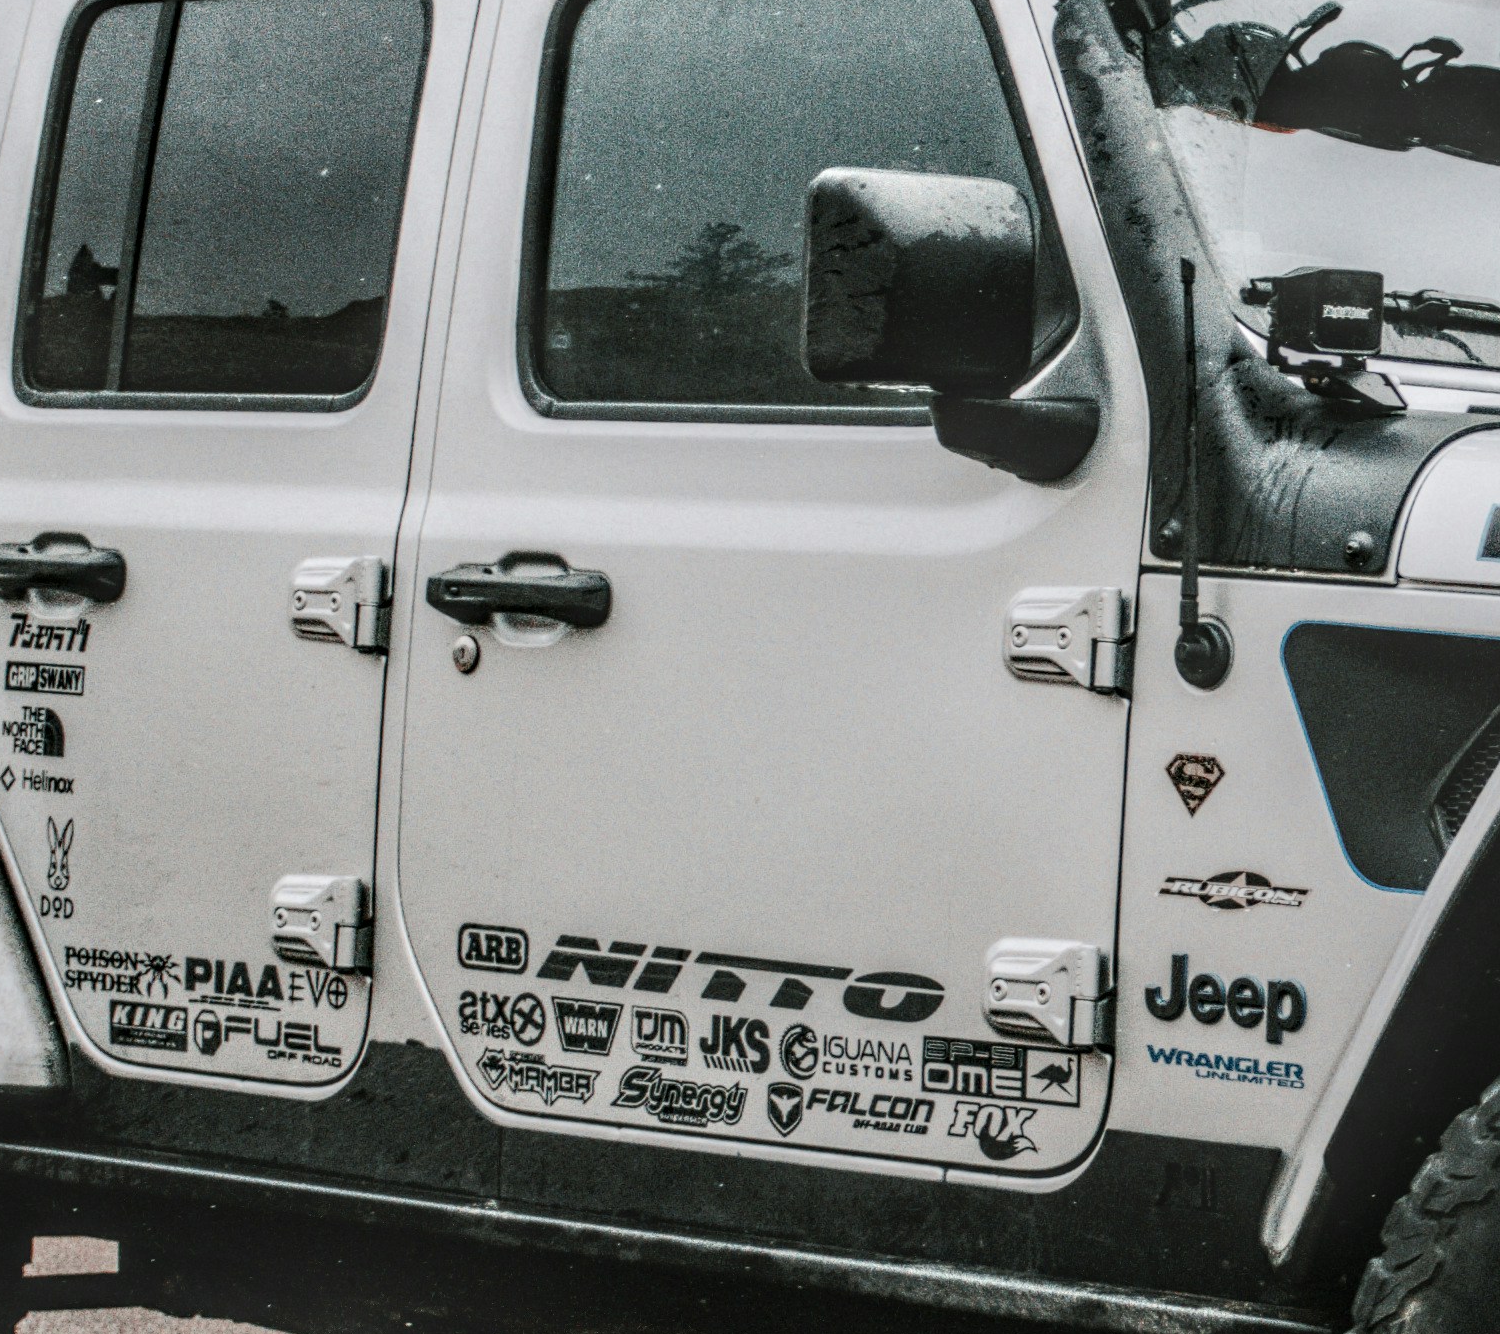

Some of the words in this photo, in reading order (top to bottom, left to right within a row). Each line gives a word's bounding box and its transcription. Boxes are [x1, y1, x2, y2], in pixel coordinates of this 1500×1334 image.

[9, 666, 37, 689] GRIP
[39, 667, 82, 692] SWANY
[22, 706, 46, 722] THE
[2, 721, 46, 738] NORTH
[13, 738, 45, 755] FACE
[22, 769, 75, 794] Helinox
[1170, 880, 1299, 903] RUBICON
[64, 946, 139, 970] POISON
[465, 932, 523, 966] ARB
[64, 970, 143, 995] SPYDER
[184, 957, 284, 1000] PIAA
[535, 933, 946, 1023] NITTO
[1145, 953, 1308, 1045] Jeep
[112, 1003, 186, 1031] KING
[460, 1020, 511, 1040] series
[564, 1015, 609, 1039] WARN
[223, 1014, 343, 1056] FUEL
[700, 1014, 771, 1074] JKS
[267, 1049, 298, 1061] OFF
[302, 1053, 342, 1068] ROAD
[822, 1034, 913, 1066] IGUANA
[1146, 1044, 1305, 1080] WRANGLER
[508, 1065, 592, 1096] MAMBA
[822, 1061, 913, 1082] CUSTOMS
[1195, 1069, 1306, 1089] UNLIMITED
[611, 1065, 748, 1124] Synergy
[806, 1087, 936, 1123] FALCON
[903, 1123, 929, 1135] CLUB
[947, 1100, 1038, 1147] FOX
